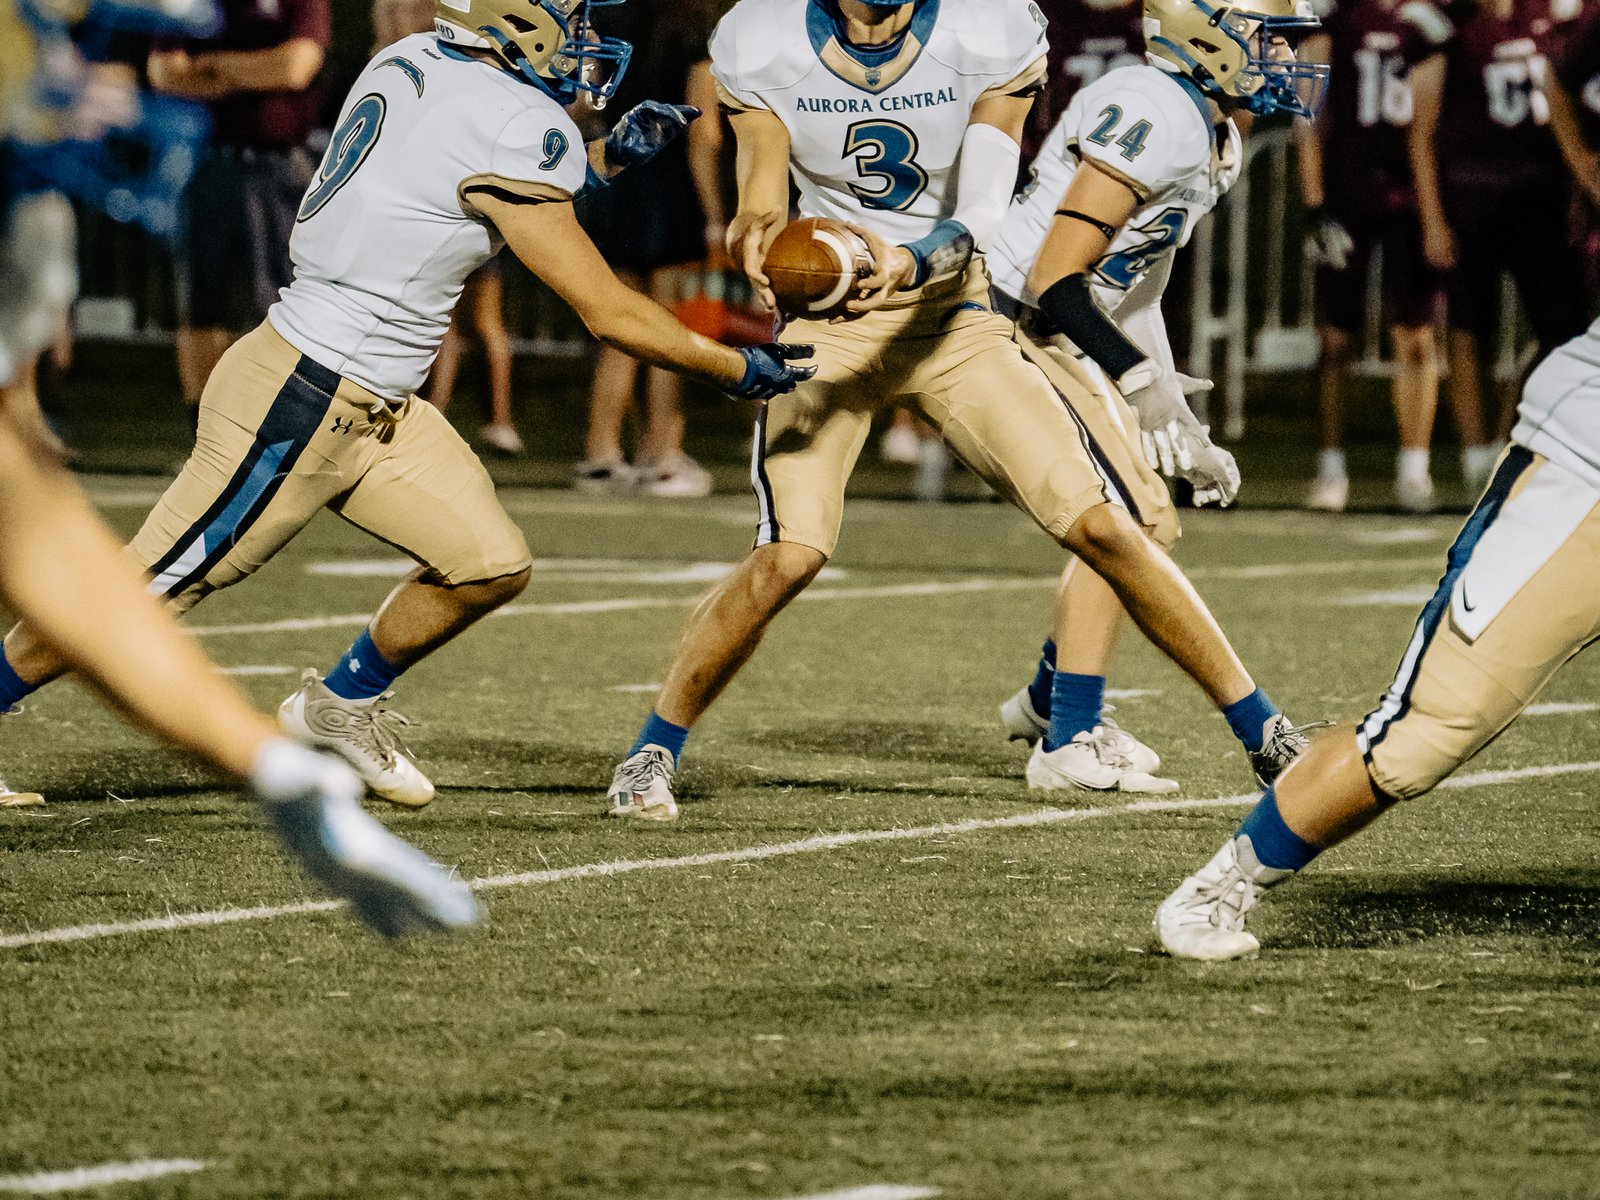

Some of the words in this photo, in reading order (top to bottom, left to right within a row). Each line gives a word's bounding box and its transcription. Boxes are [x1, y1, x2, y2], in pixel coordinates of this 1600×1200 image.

[796, 97, 874, 113] AURORA
[879, 86, 957, 112] CENTRAL
[297, 92, 387, 223] 9
[538, 128, 569, 171] 9
[1086, 103, 1153, 163] 24
[842, 119, 929, 210] 3
